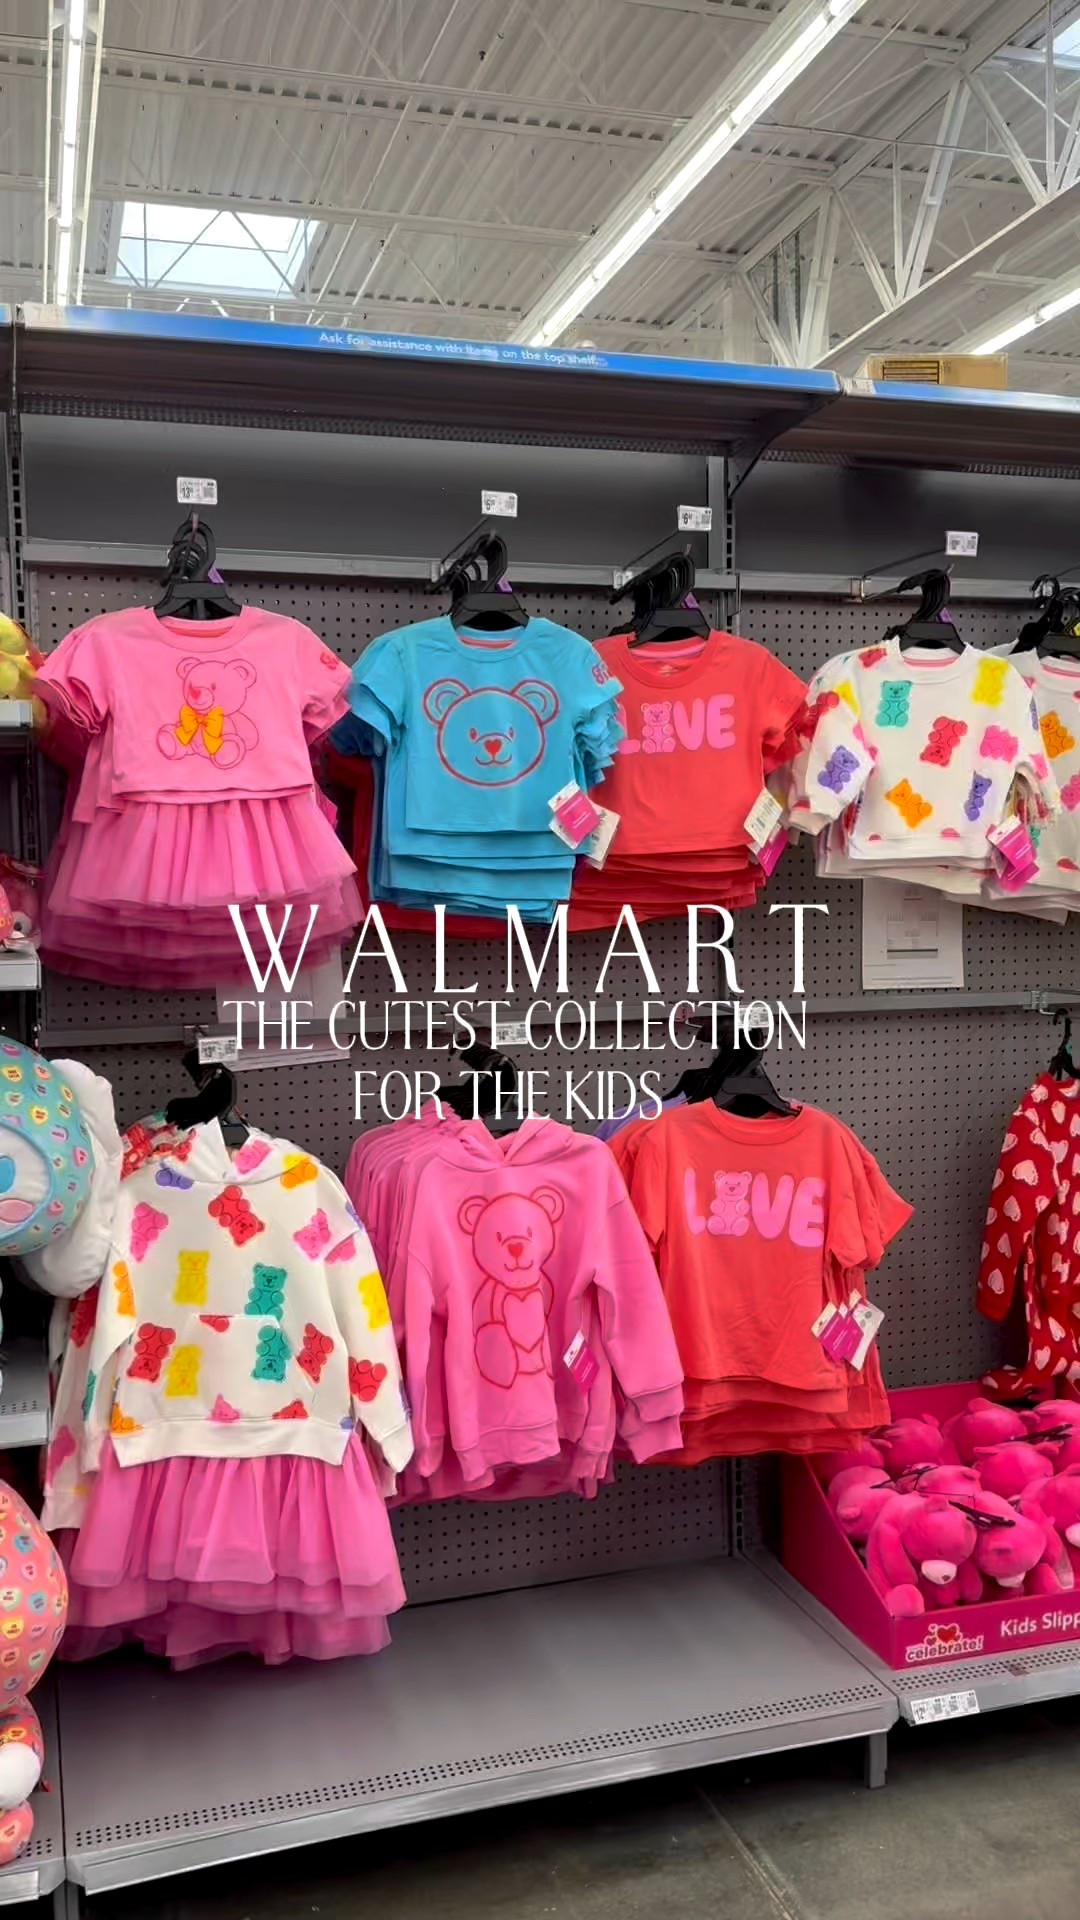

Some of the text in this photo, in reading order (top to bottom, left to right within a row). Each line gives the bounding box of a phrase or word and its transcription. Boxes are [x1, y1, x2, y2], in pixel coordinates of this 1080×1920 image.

[319, 331, 343, 345] Ask
[368, 338, 432, 352] assistance
[435, 342, 462, 354] with
[502, 350, 518, 360] on
[521, 350, 542, 361] the
[544, 353, 564, 366] top
[1001, 1616, 1037, 1637] Kids
[907, 1636, 983, 1661] celebrate!
